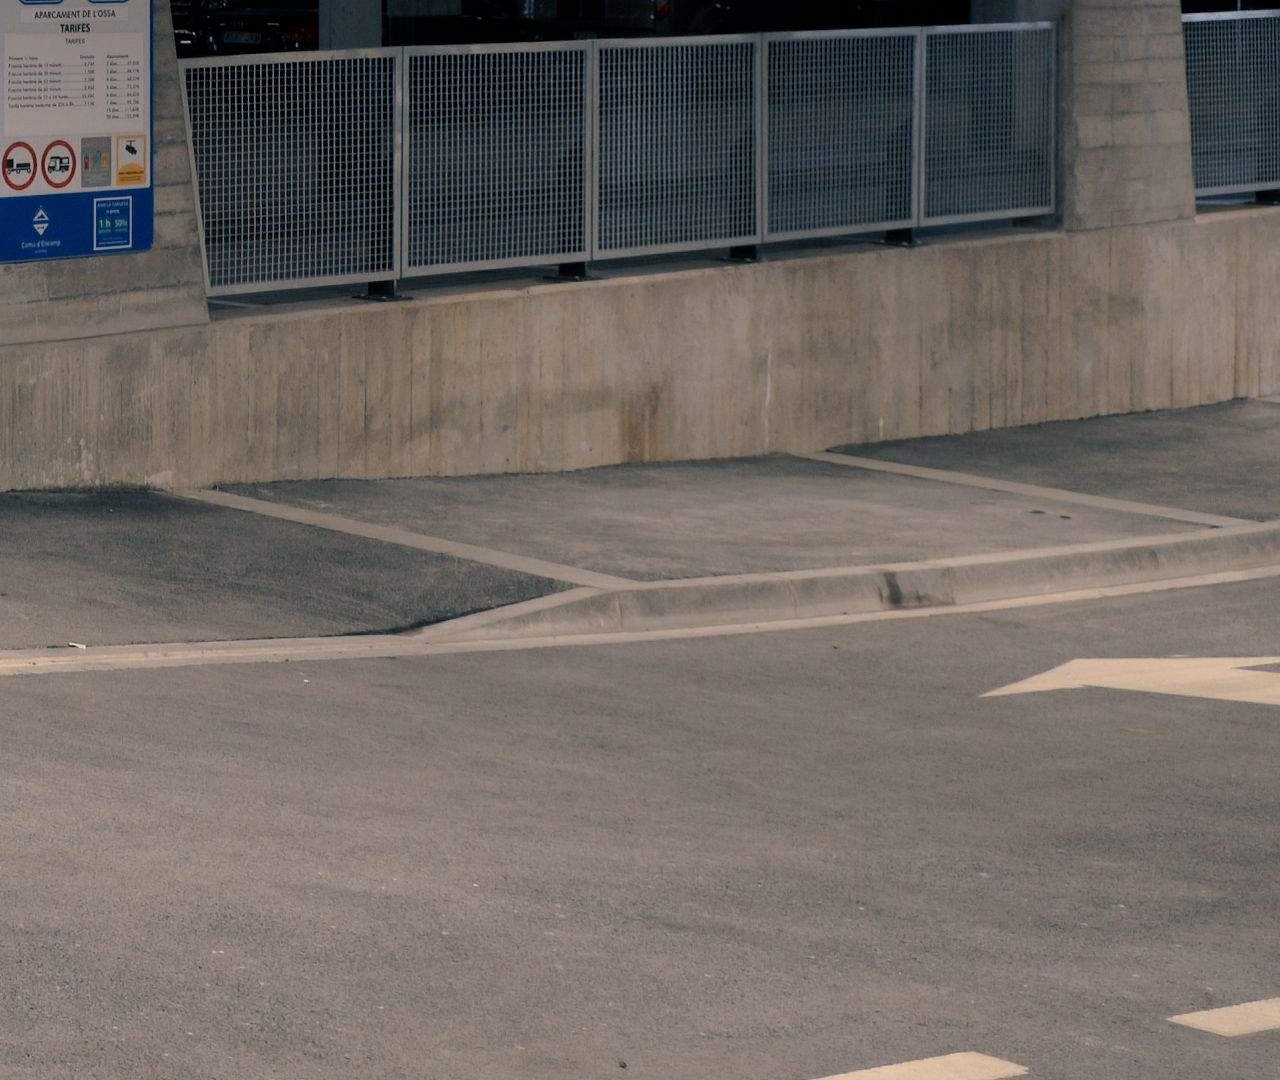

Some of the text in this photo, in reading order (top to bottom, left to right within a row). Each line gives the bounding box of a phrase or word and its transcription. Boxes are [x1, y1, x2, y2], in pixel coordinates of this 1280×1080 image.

[34, 10, 81, 19] APARCAMENT
[82, 10, 92, 18] DE
[60, 23, 91, 33] TARIFES
